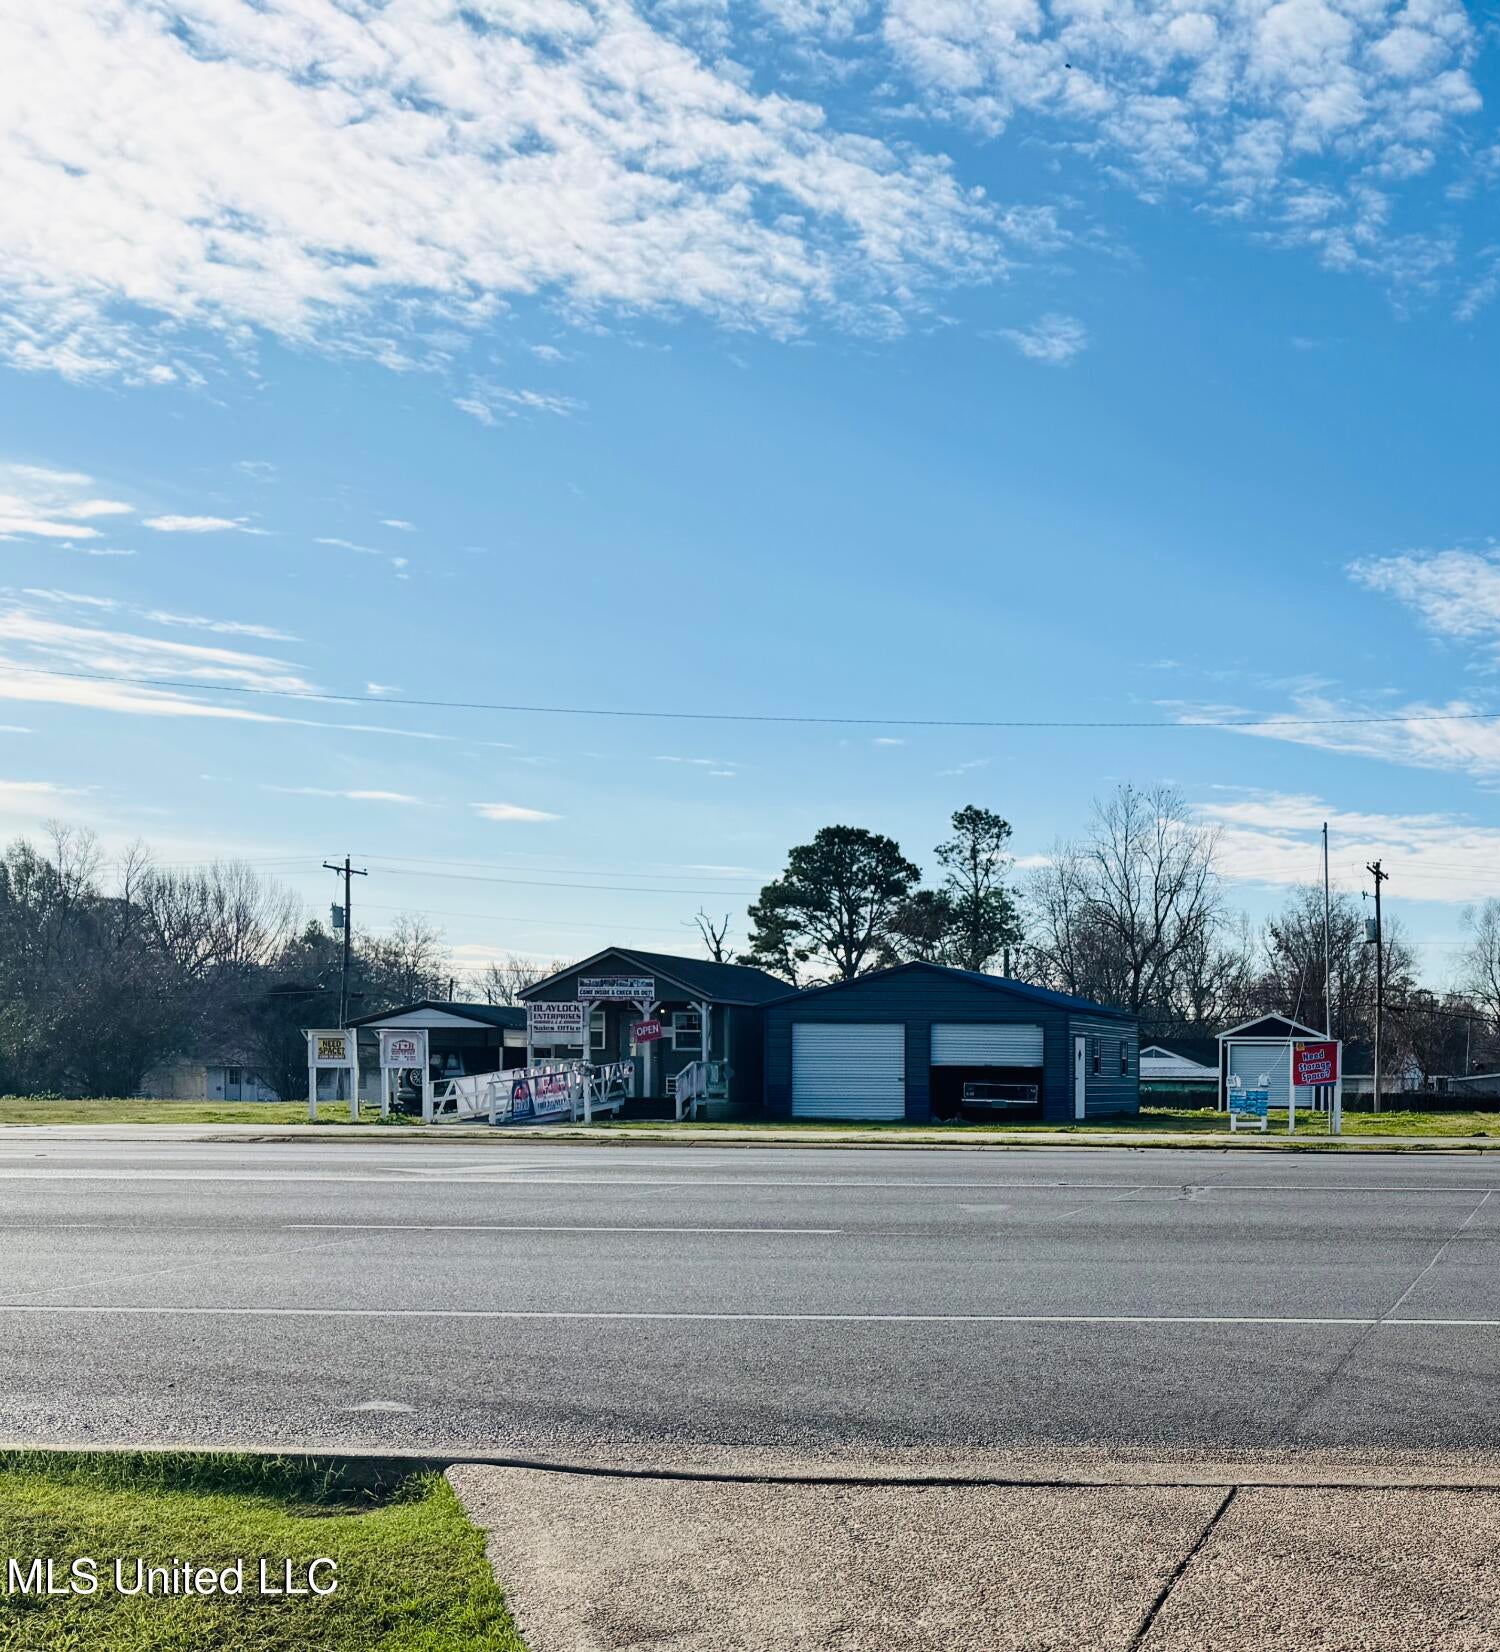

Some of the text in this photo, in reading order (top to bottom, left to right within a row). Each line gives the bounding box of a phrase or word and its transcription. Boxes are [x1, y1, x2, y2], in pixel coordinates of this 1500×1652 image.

[533, 1004, 581, 1012] BLAYLOCK
[636, 1023, 660, 1037] OPEN
[322, 1040, 342, 1048] NEED
[318, 1047, 345, 1056] SPACE?
[1302, 1049, 1325, 1062] Need
[1298, 1061, 1332, 1072] Storage
[1302, 1070, 1331, 1083] Space?
